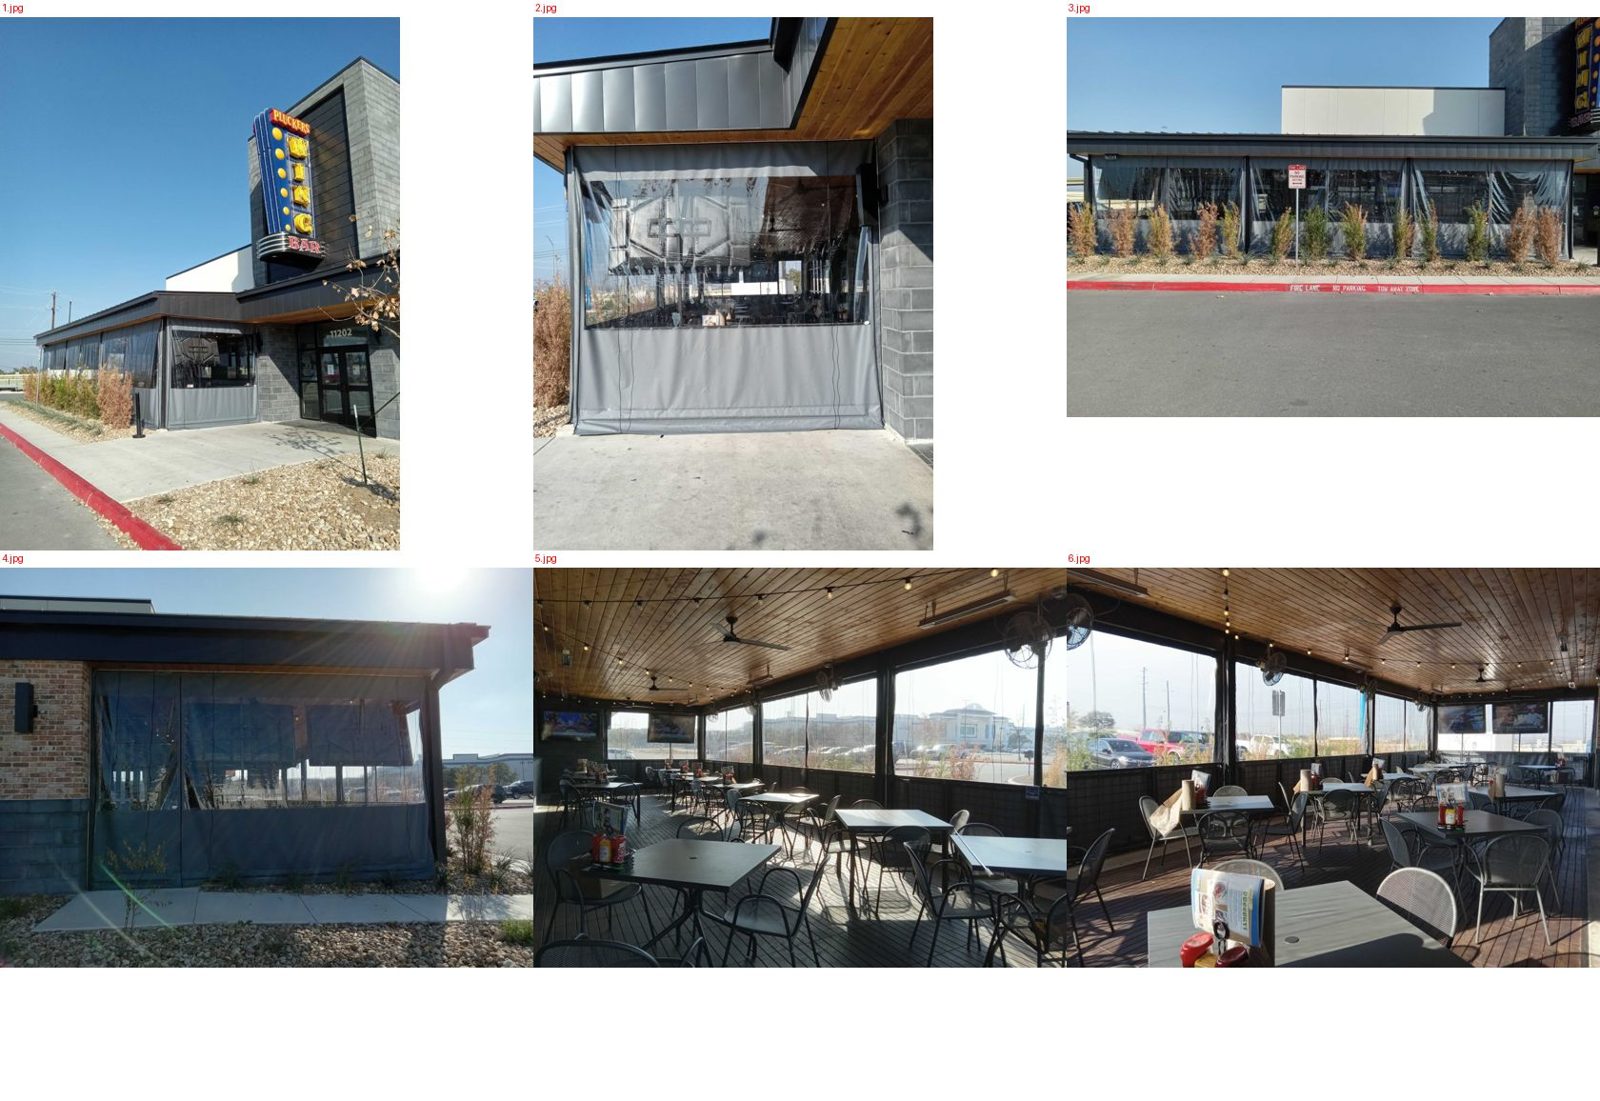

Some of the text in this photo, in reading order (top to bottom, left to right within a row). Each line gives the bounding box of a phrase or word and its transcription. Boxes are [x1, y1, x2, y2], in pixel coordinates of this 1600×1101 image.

[272, 109, 311, 134] PLUCKERS
[287, 136, 313, 236] WING
[288, 235, 321, 253] BAR
[330, 328, 352, 337] 11202
